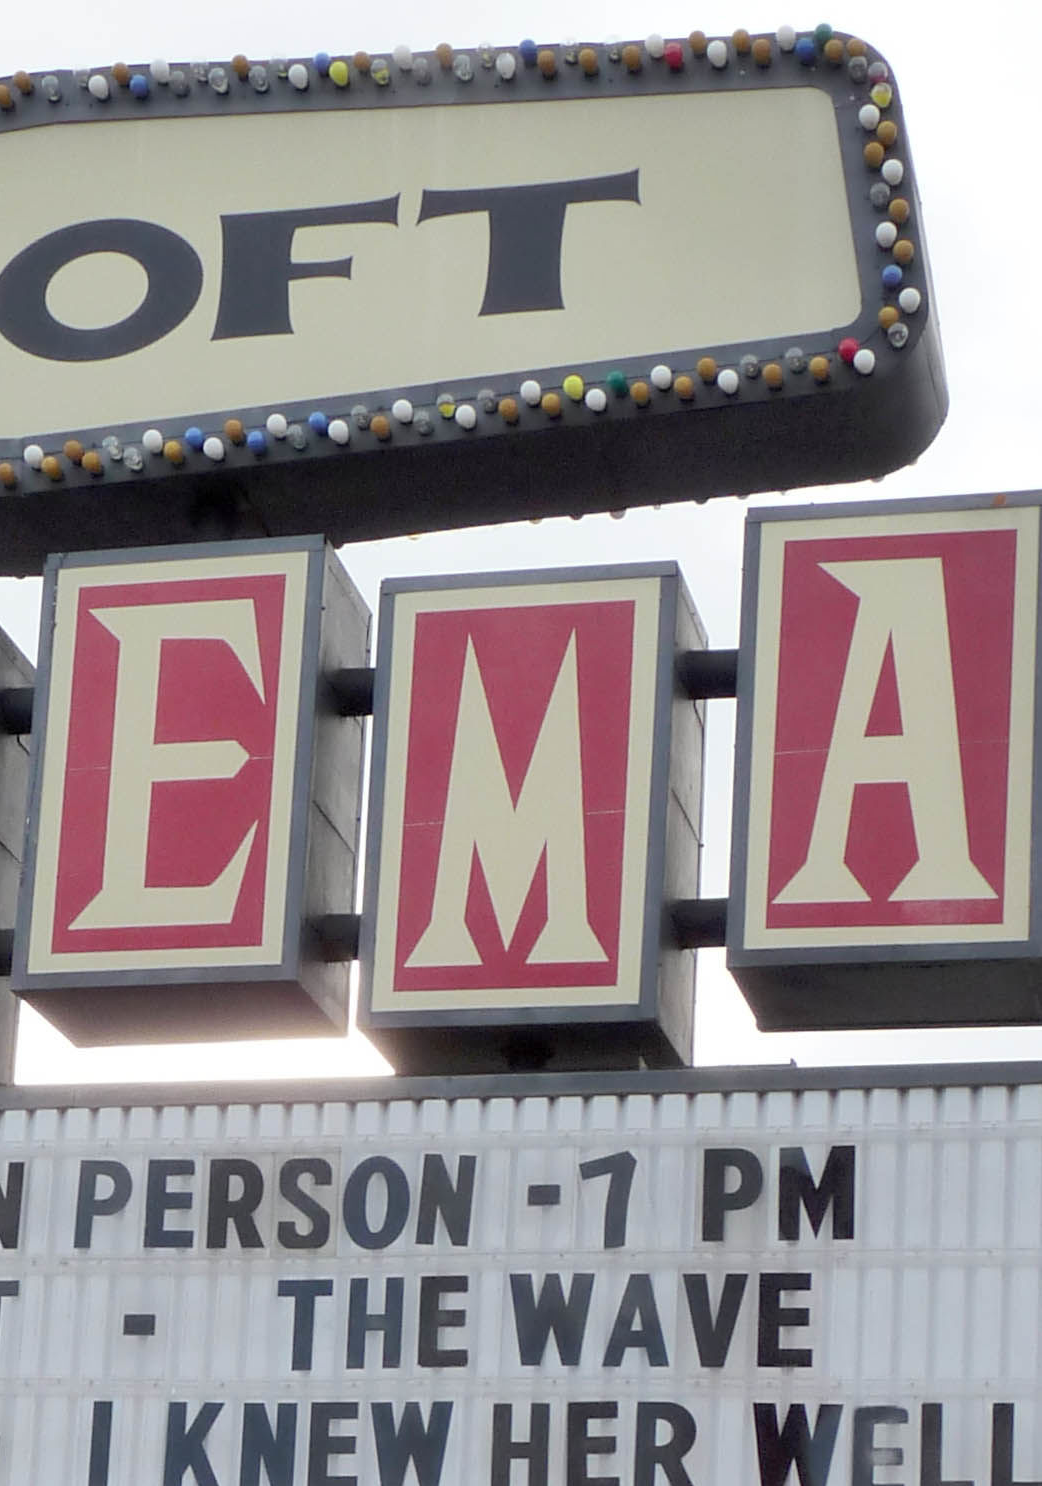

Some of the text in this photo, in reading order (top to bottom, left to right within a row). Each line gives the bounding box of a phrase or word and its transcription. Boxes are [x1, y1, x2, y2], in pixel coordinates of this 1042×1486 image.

[73, 1157, 477, 1251] PERSON
[701, 1145, 856, 1243] PM
[277, 1275, 469, 1372] THE
[509, 1271, 814, 1369] WAVE
